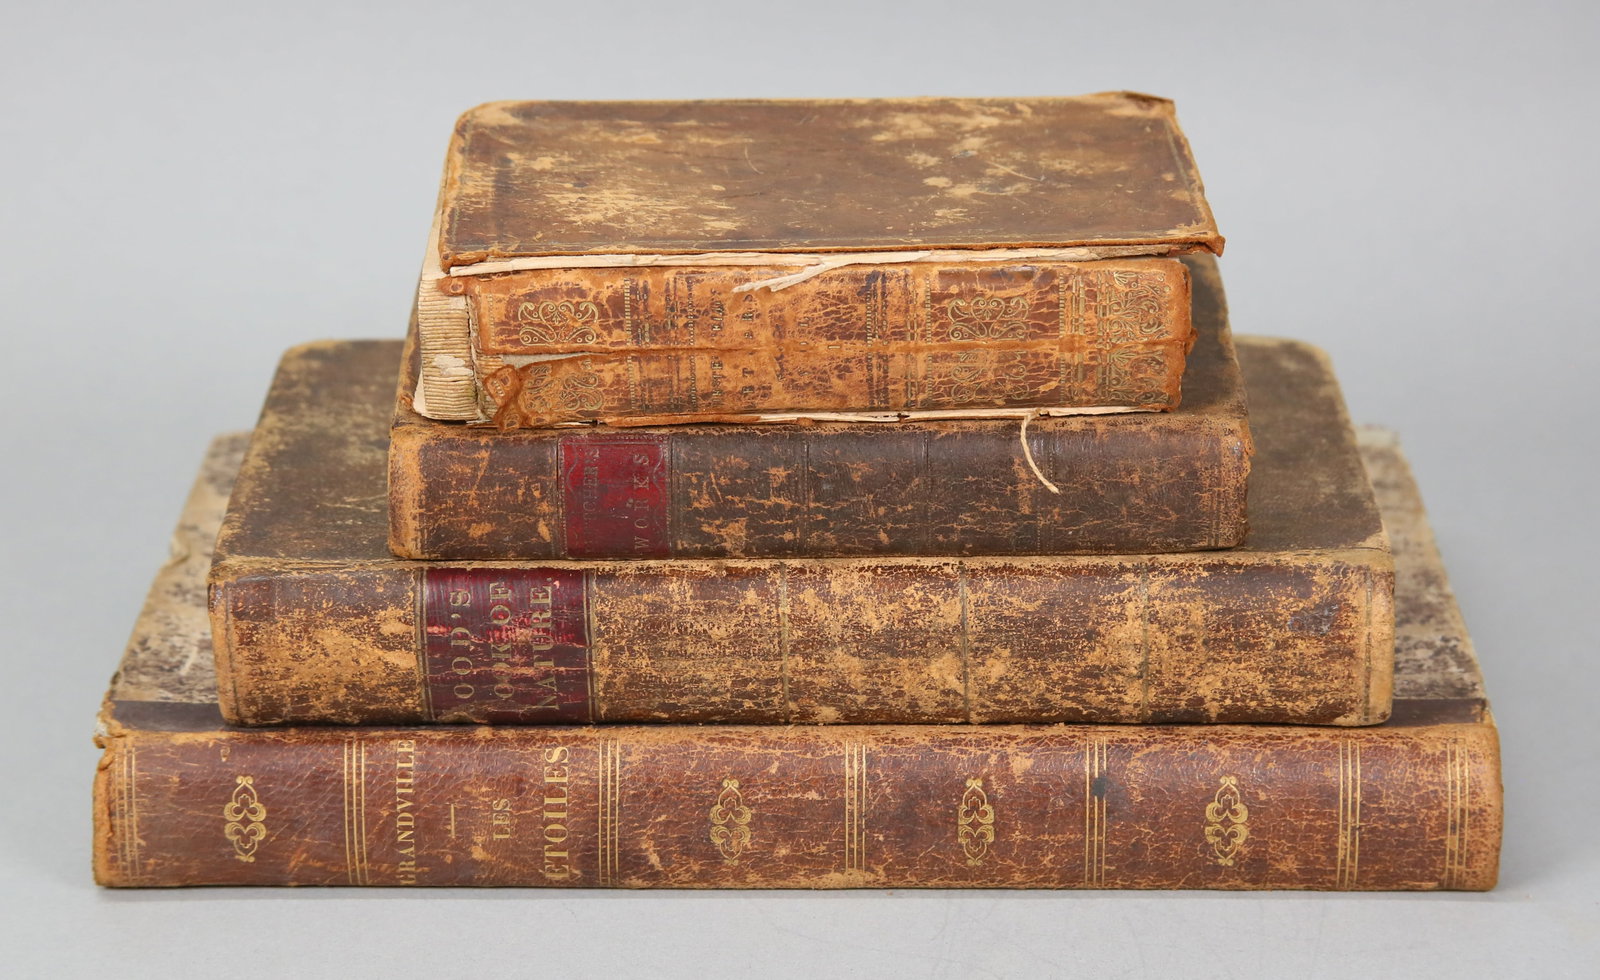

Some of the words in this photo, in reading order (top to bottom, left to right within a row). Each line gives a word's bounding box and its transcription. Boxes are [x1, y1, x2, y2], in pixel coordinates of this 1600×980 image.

[633, 453, 649, 550] WORKS
[490, 581, 512, 625] OF
[450, 589, 475, 712] OOD'S
[491, 640, 514, 710] OOK
[396, 739, 416, 884] GRANDVILLE
[493, 798, 511, 840] LES
